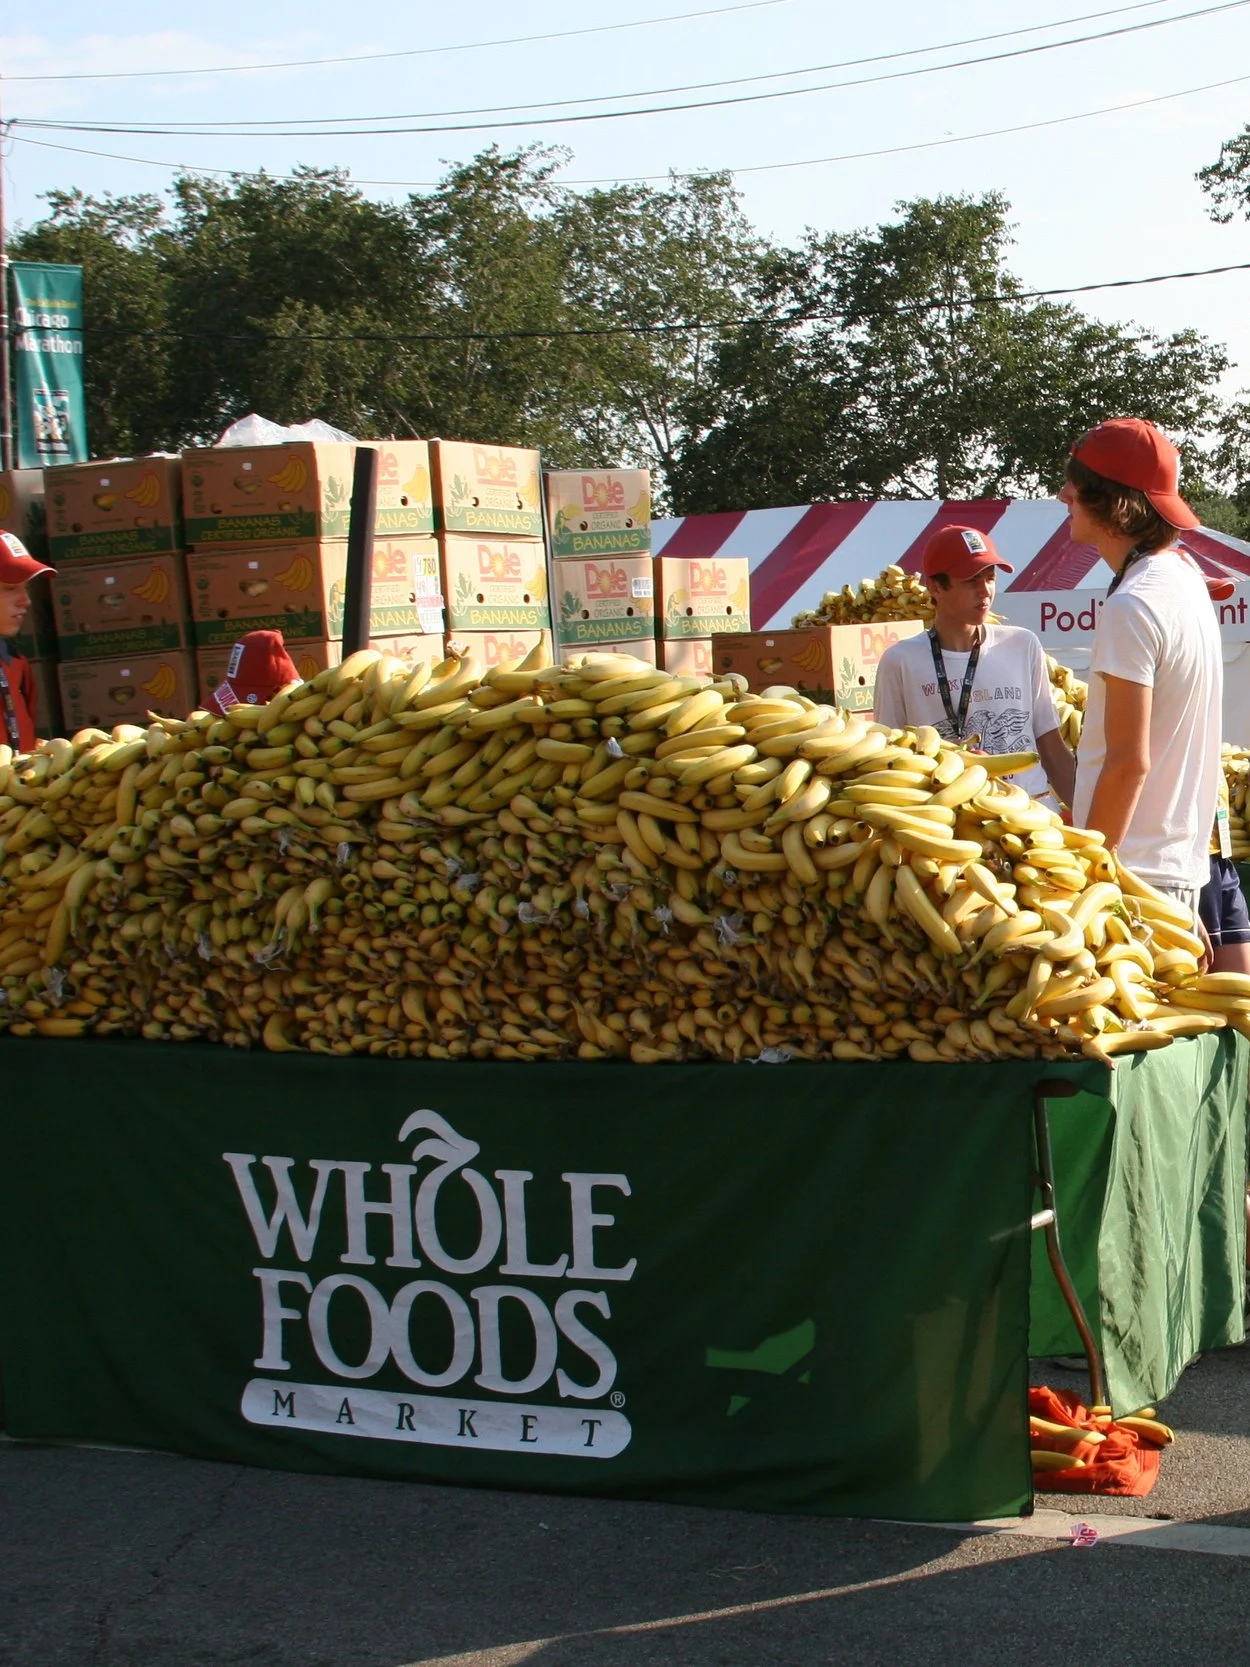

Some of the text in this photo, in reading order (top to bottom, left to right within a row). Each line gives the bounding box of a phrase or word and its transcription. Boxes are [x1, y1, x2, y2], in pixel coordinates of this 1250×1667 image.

[15, 307, 71, 329] Chicago
[14, 331, 84, 354] Marathon
[472, 447, 517, 482] Dole
[581, 474, 625, 507] Dole
[218, 516, 281, 529] BANANAS
[465, 510, 532, 530] BANANAS
[591, 519, 621, 530] ORGANIC
[79, 531, 139, 546] BANANAS
[201, 527, 301, 541] CERTIFIED ORGANIC
[573, 533, 641, 552] BANANAS
[373, 543, 407, 578] ole
[477, 544, 521, 579] Dole
[584, 562, 628, 596] Dole
[688, 562, 727, 594] Dole
[373, 584, 400, 594] ERTIFIED
[487, 594, 520, 605] ORGANIC
[470, 609, 538, 626] BANANAS
[593, 606, 626, 618] ORGANIC
[1219, 597, 1248, 625] nt
[225, 616, 288, 631] BANANAS
[576, 620, 643, 640] BANANAS
[681, 618, 741, 634] BANANAS
[88, 629, 147, 645] BANANAS
[861, 625, 899, 658] Dole
[484, 634, 528, 666] Dole
[222, 1109, 638, 1281] WHOLE
[252, 1267, 618, 1400] FOODS
[272, 1389, 602, 1447] MARKET
